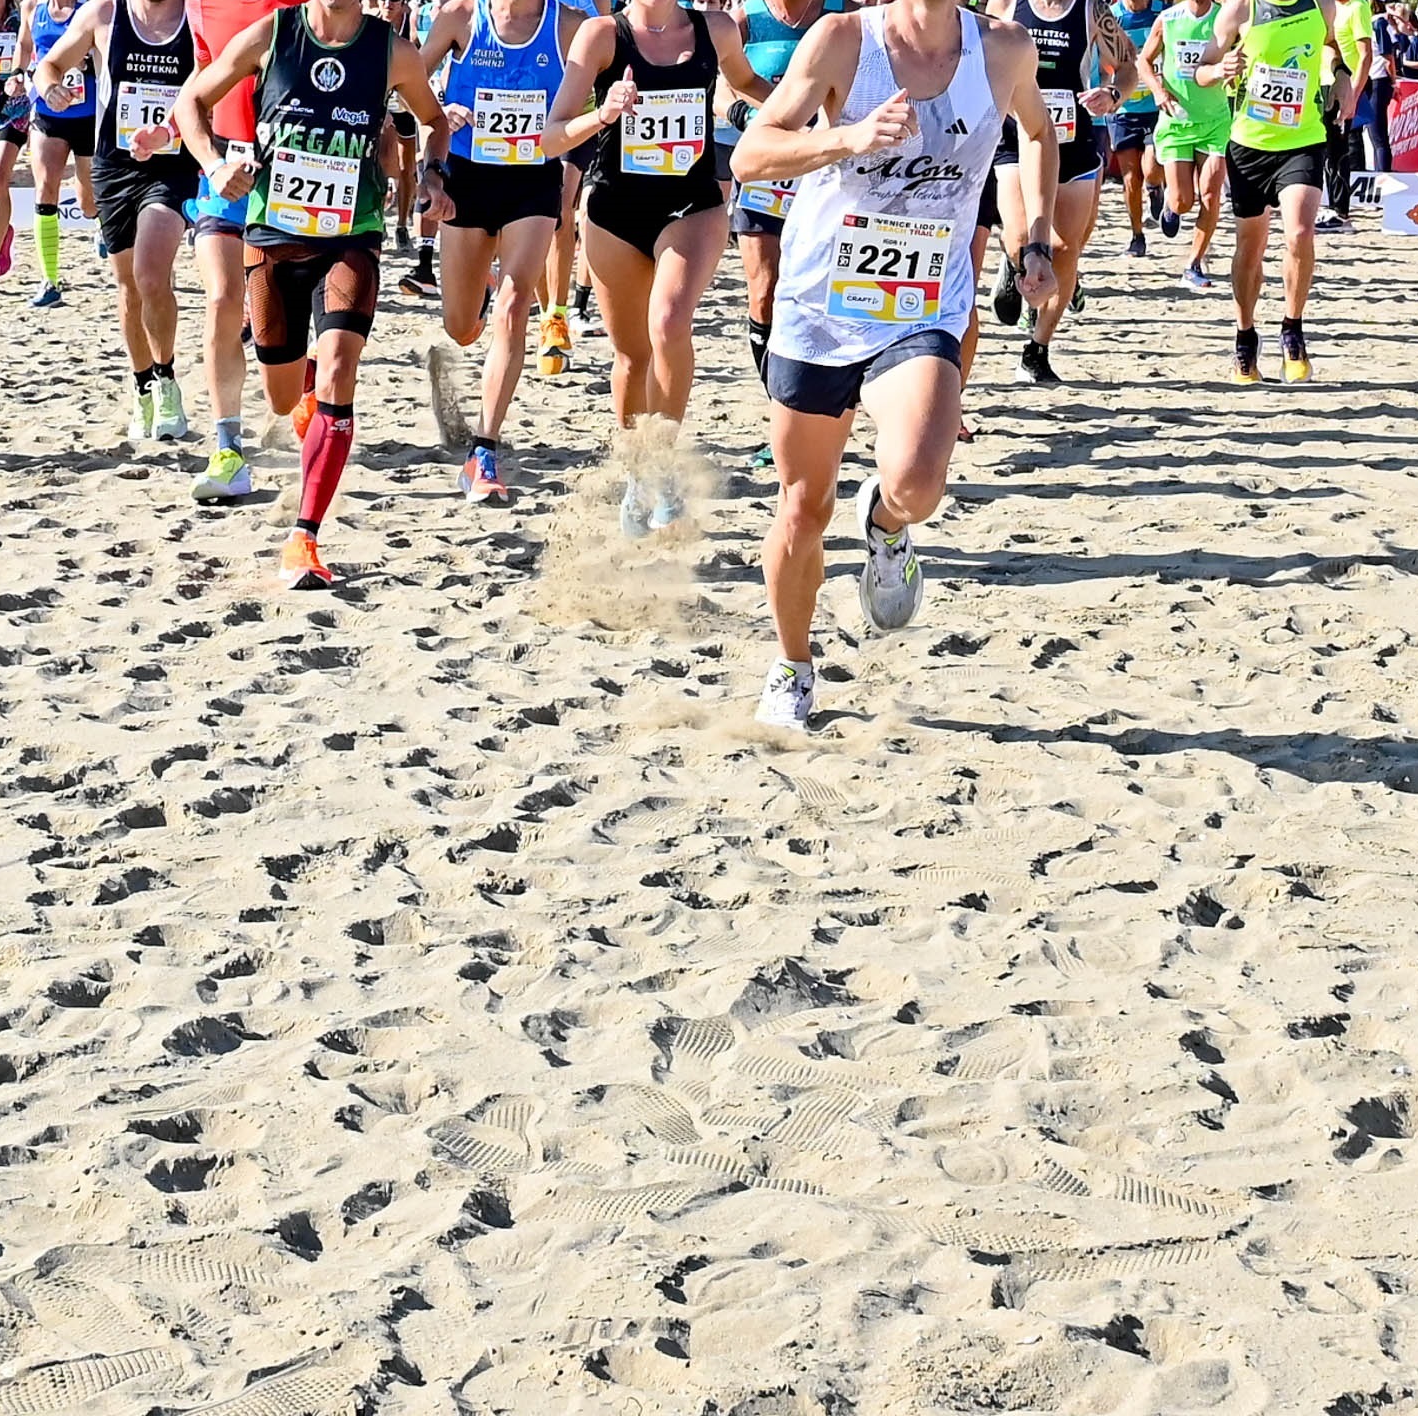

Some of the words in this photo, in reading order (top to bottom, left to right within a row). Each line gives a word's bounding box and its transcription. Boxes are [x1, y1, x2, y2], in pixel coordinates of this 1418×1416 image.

[1027, 28, 1070, 40] ATLETICA
[1033, 37, 1070, 48] IOTEKNA
[126, 52, 180, 65] ATLETICA
[473, 49, 504, 58] ATLETICA
[126, 63, 179, 75] BIOTEKNA
[1260, 83, 1294, 103] 226
[140, 104, 165, 126] 16
[489, 112, 532, 135] 237
[640, 115, 686, 141] 311
[287, 176, 336, 207] 271
[878, 218, 911, 229] VENICE
[914, 222, 936, 231] LIDO
[909, 228, 933, 237] TRAIL
[856, 244, 920, 280] 221
[846, 295, 873, 303] CRAFT
